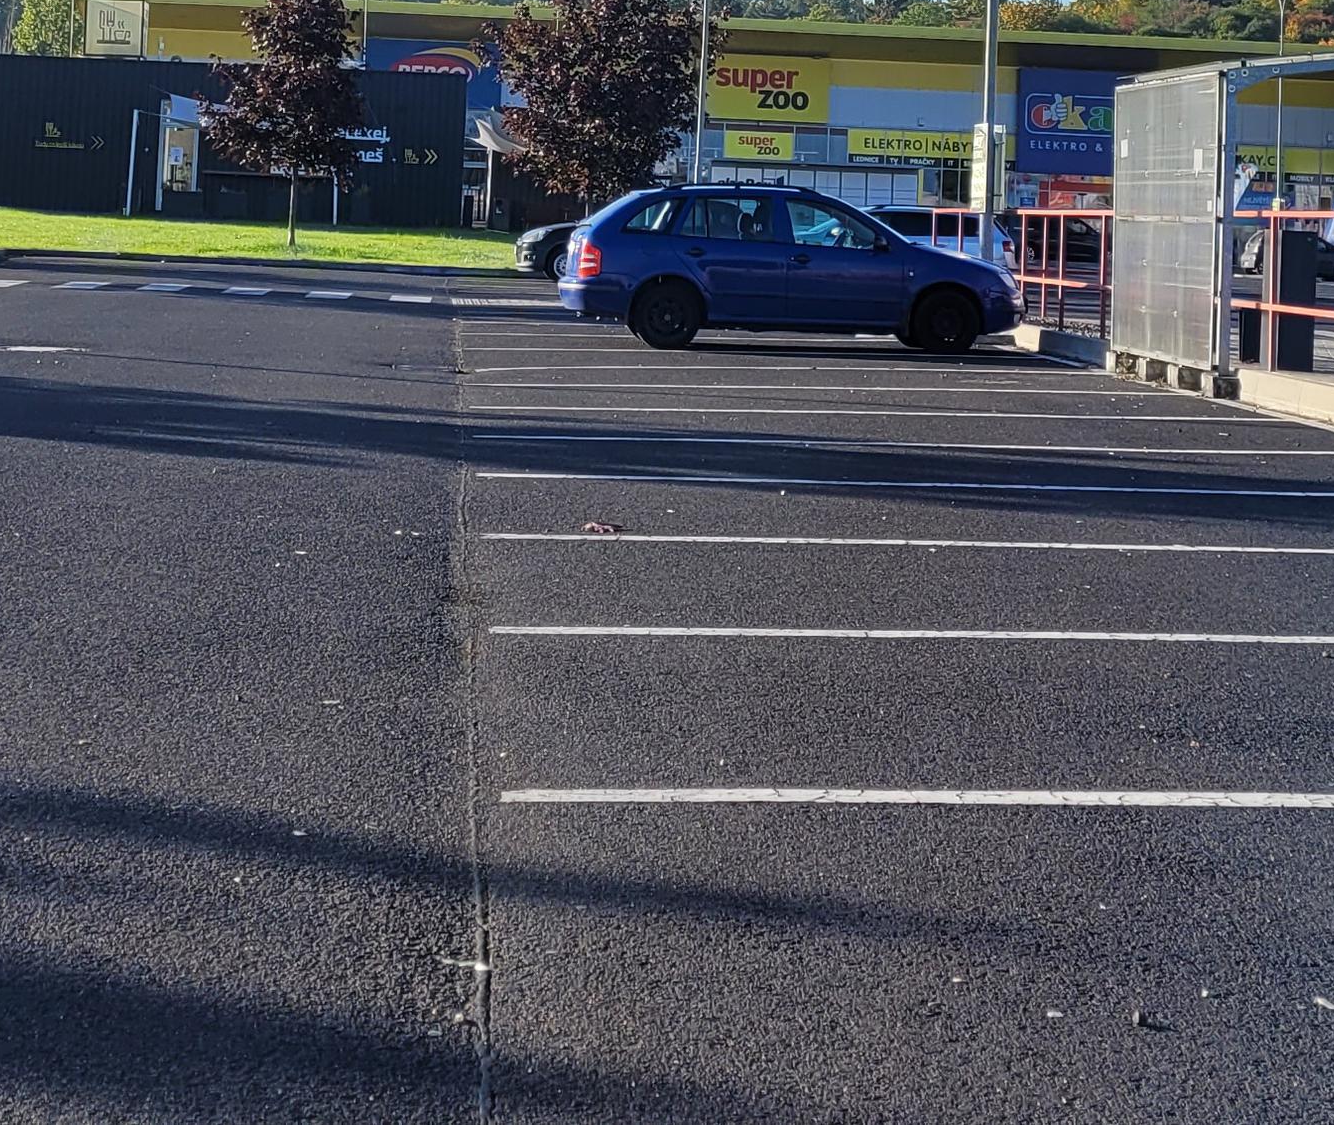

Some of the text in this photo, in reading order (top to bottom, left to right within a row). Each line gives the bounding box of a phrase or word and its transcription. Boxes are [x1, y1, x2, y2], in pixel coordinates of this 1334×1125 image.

[716, 67, 799, 93] super
[1031, 95, 1114, 131] oka
[738, 136, 776, 147] super
[864, 137, 973, 153] ELEKTRO NÁBY
[1030, 140, 1103, 152] ELEKTRO &
[853, 156, 879, 164] LEDNICE
[909, 157, 936, 166] PRAČKY
[1239, 154, 1276, 167] KAY.C
